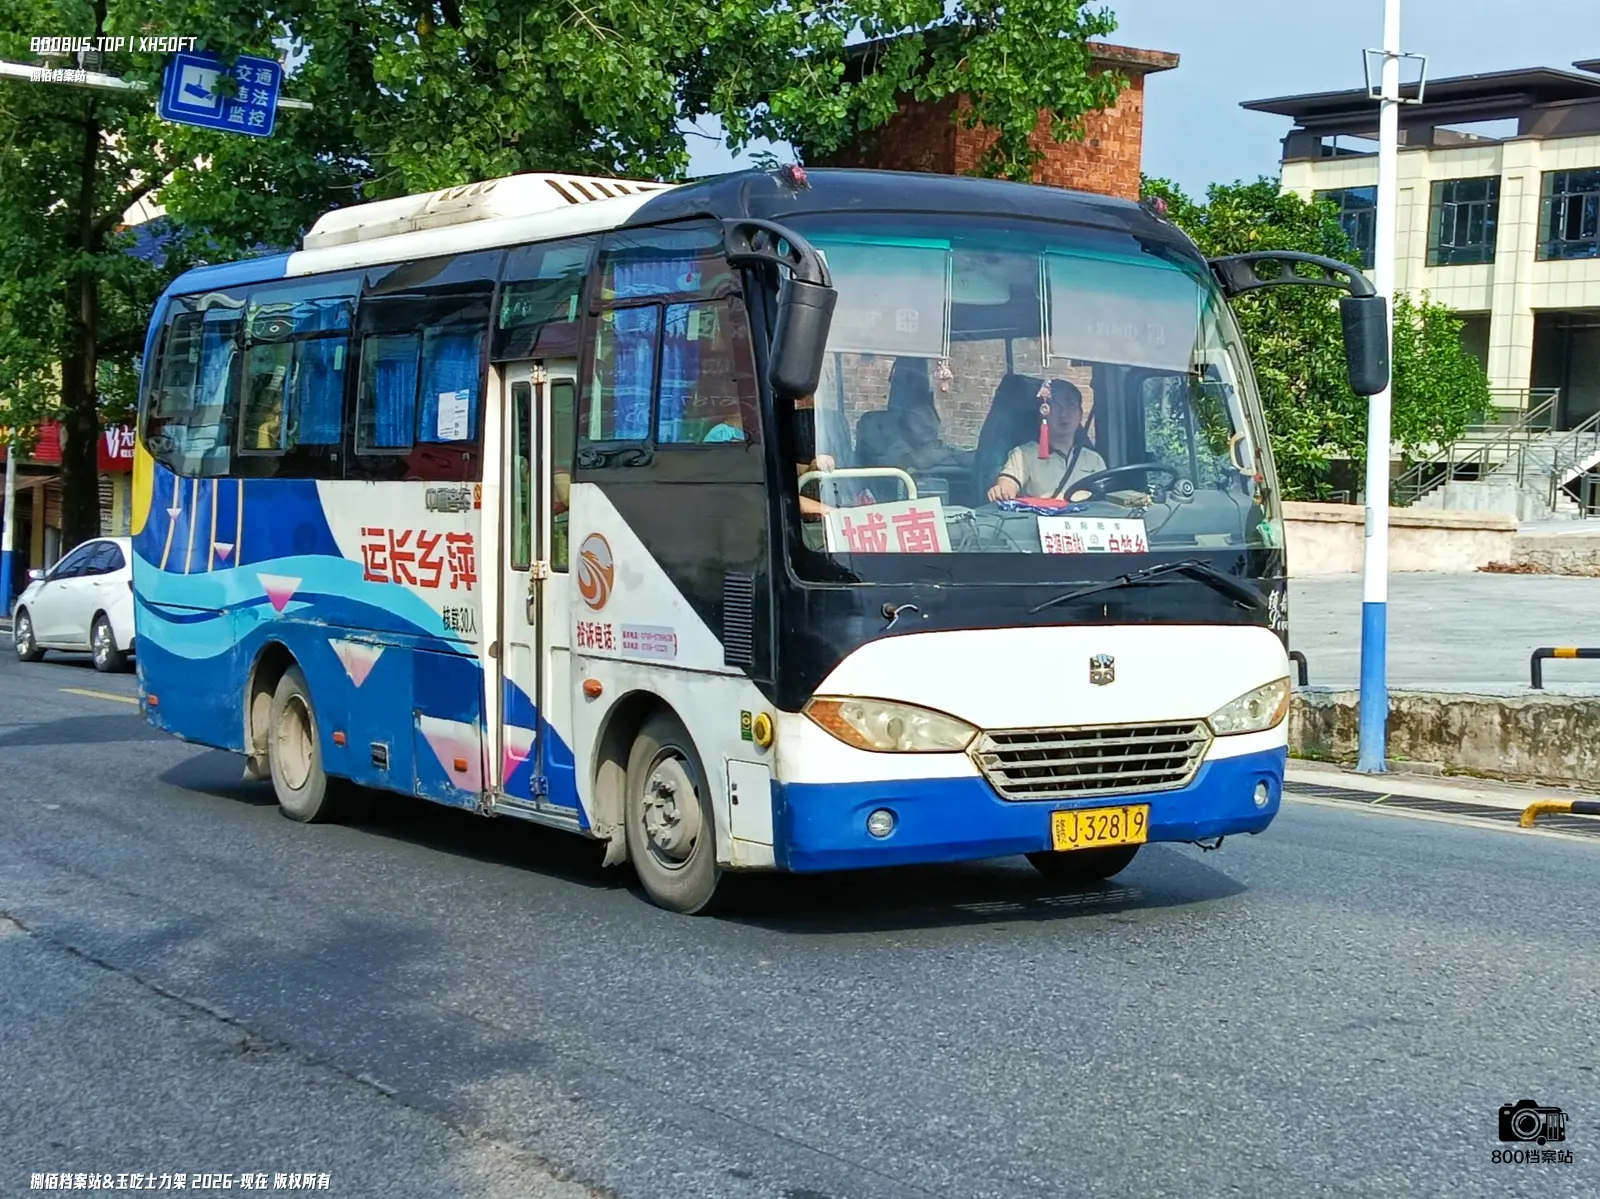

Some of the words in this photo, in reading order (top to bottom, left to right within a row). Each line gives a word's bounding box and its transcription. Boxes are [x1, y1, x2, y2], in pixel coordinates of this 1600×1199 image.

[235, 64, 273, 86] 交通
[232, 86, 269, 107] 违法
[227, 106, 267, 128] 监控
[842, 507, 941, 553] 城南
[443, 605, 477, 634] 核载30人
